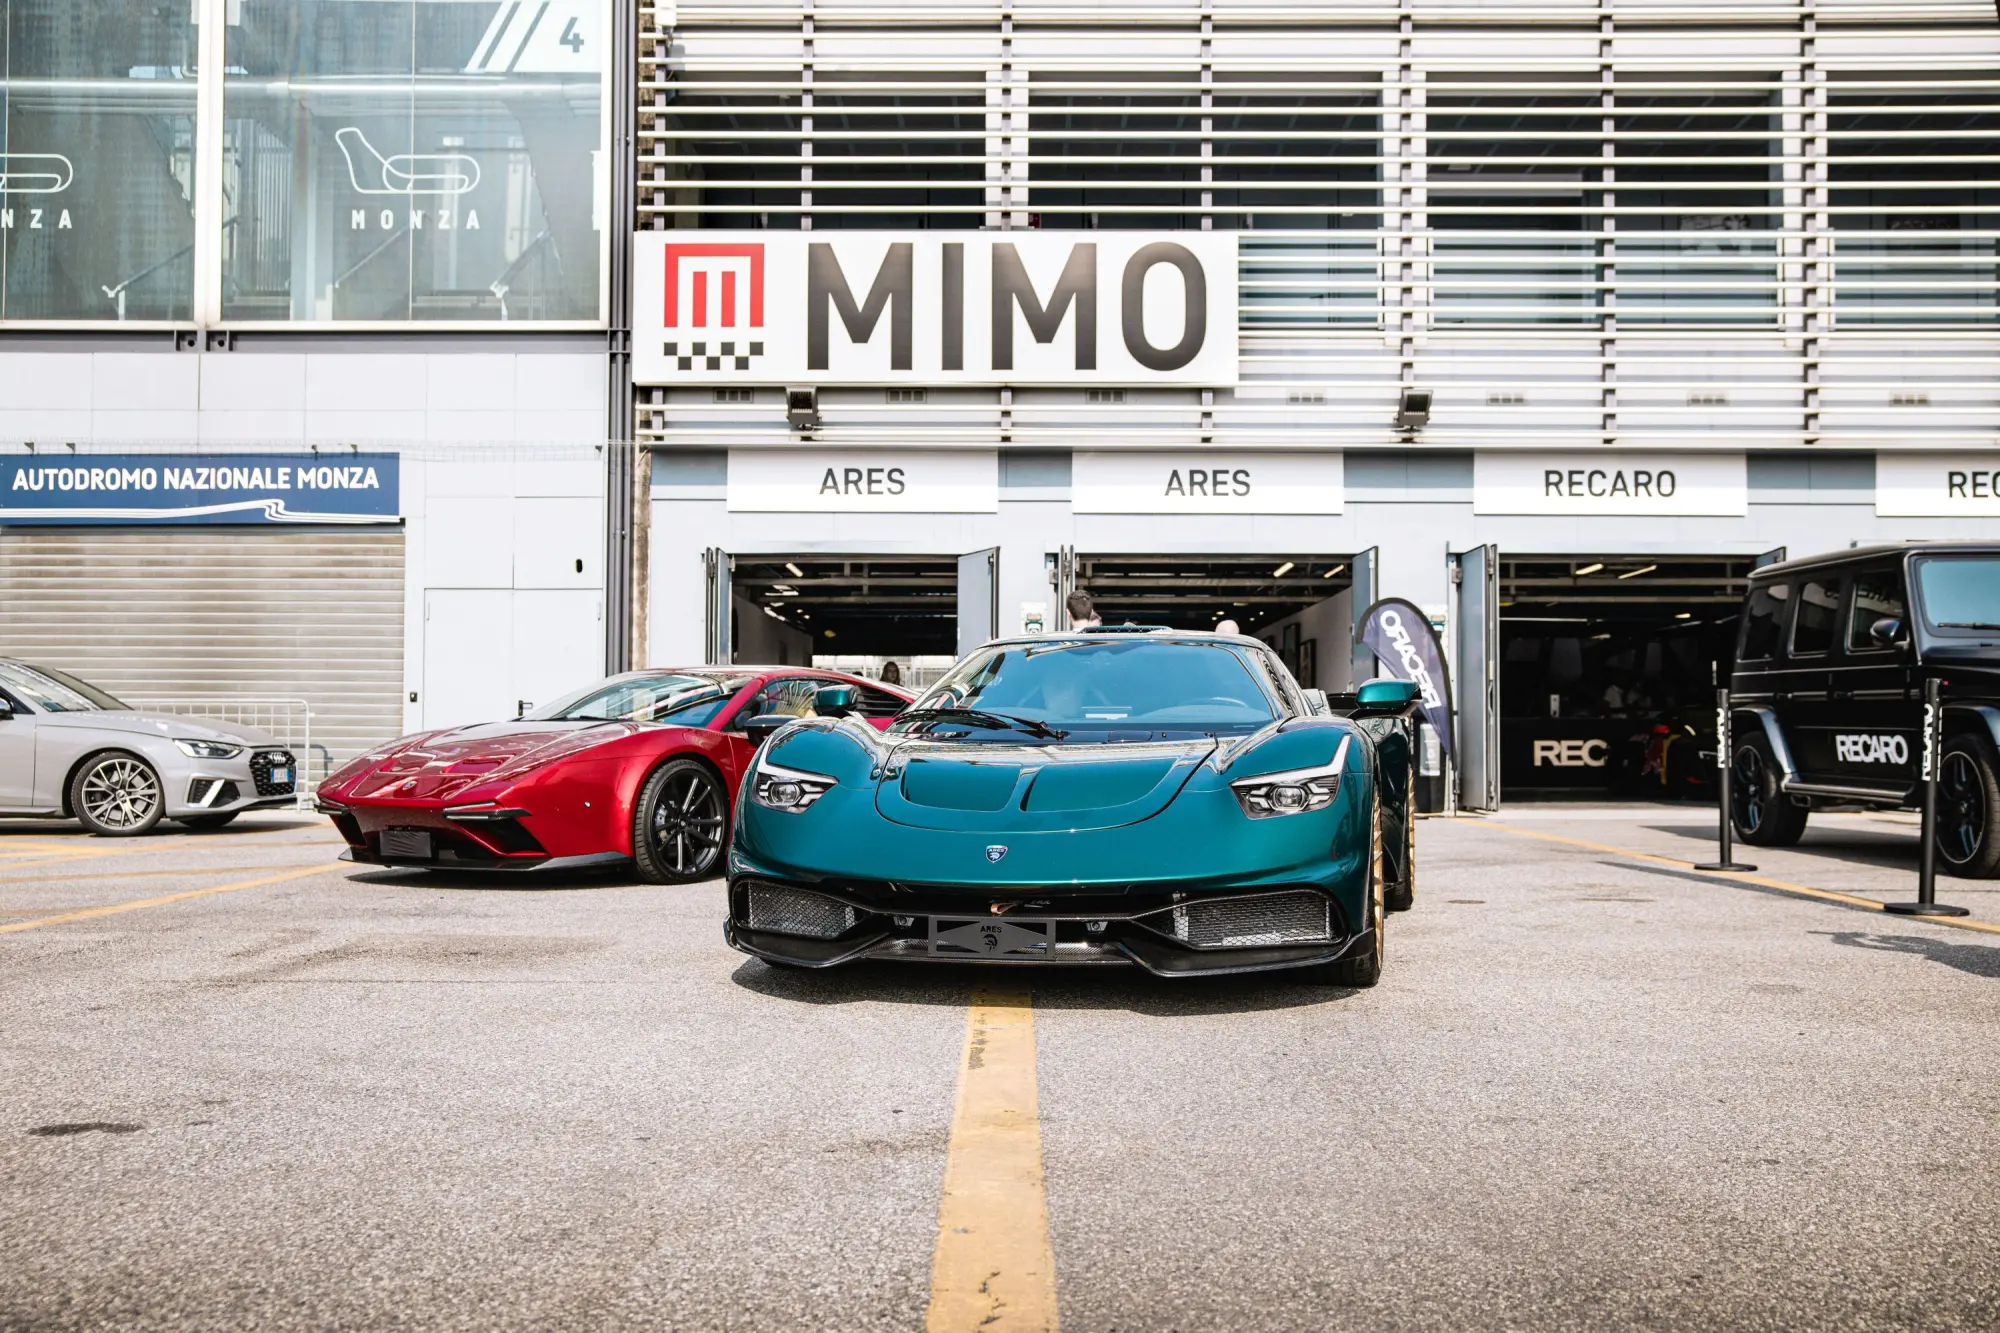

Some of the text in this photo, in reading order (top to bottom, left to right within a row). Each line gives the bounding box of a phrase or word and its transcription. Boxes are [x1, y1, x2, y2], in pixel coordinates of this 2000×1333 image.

[559, 16, 585, 53] 4
[351, 209, 480, 230] MONZA
[807, 241, 1207, 371] MIMO
[12, 466, 380, 491] AUTODROMO NAZIONALE MONZA
[819, 467, 905, 495] ARES
[1164, 468, 1251, 496] ARES
[1544, 469, 1677, 498] RECARO
[1835, 734, 1909, 765] RECARO
[980, 925, 1003, 933] ARES
